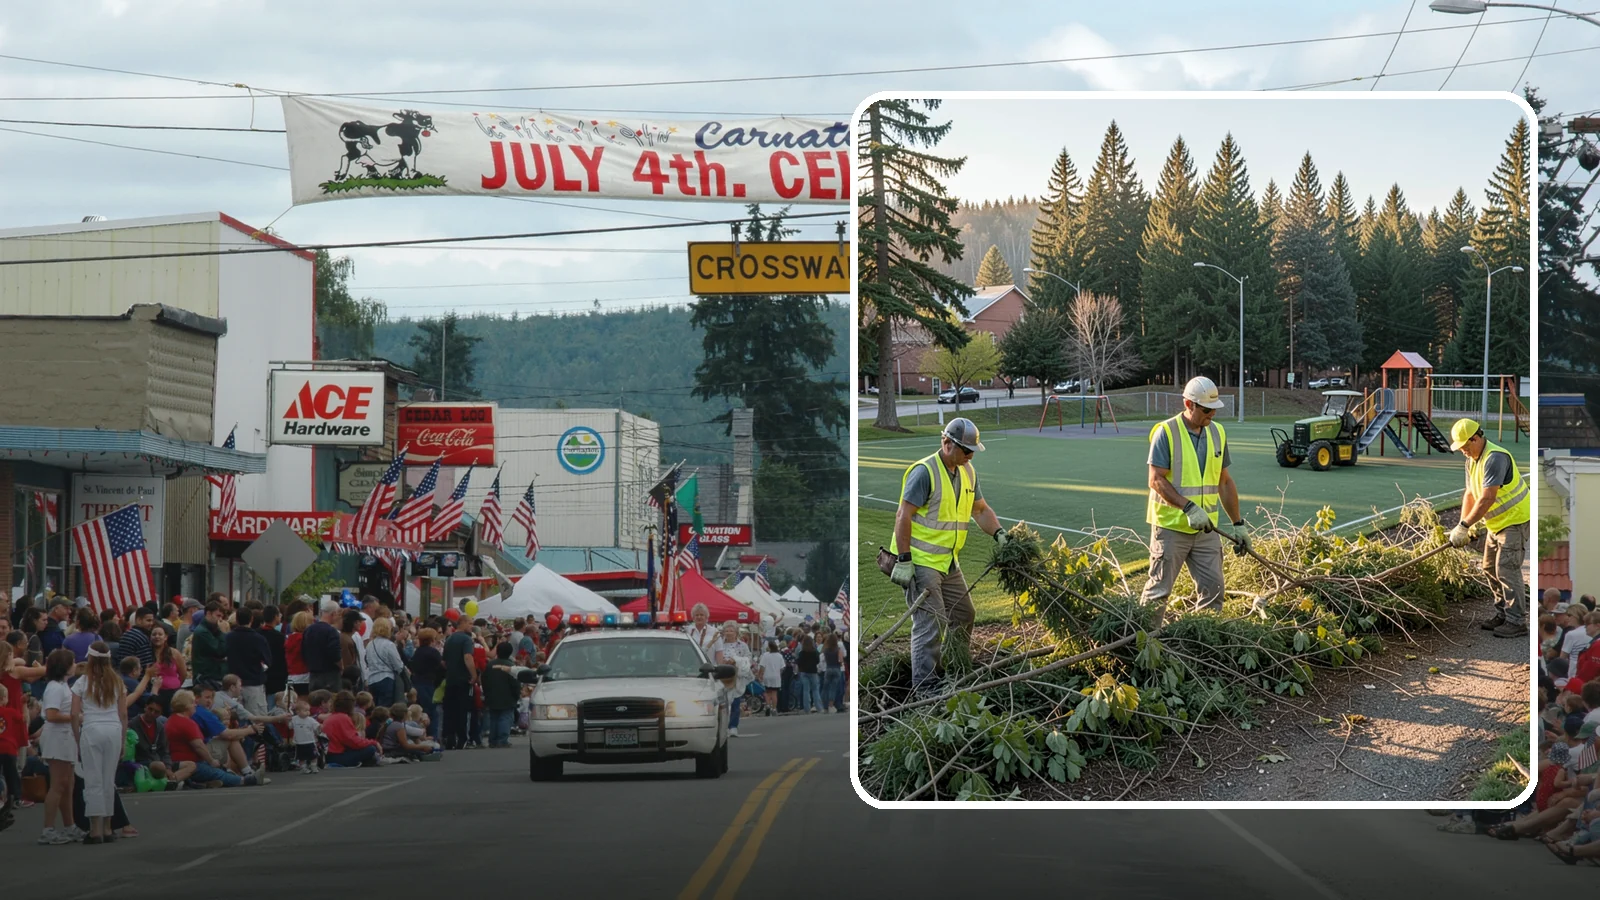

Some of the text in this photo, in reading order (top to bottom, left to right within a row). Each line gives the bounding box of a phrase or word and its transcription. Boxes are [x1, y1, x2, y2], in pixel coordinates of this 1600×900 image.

[481, 141, 604, 192] JULY
[632, 150, 746, 198] 4th.
[697, 254, 850, 280] CROSSWA
[283, 380, 373, 420] ACE
[406, 409, 453, 422] CEDAR
[284, 421, 371, 437] Hardware
[96, 485, 124, 495] Vincent
[126, 486, 136, 495] de
[138, 486, 155, 496] Paul
[688, 526, 741, 535] CRNATION
